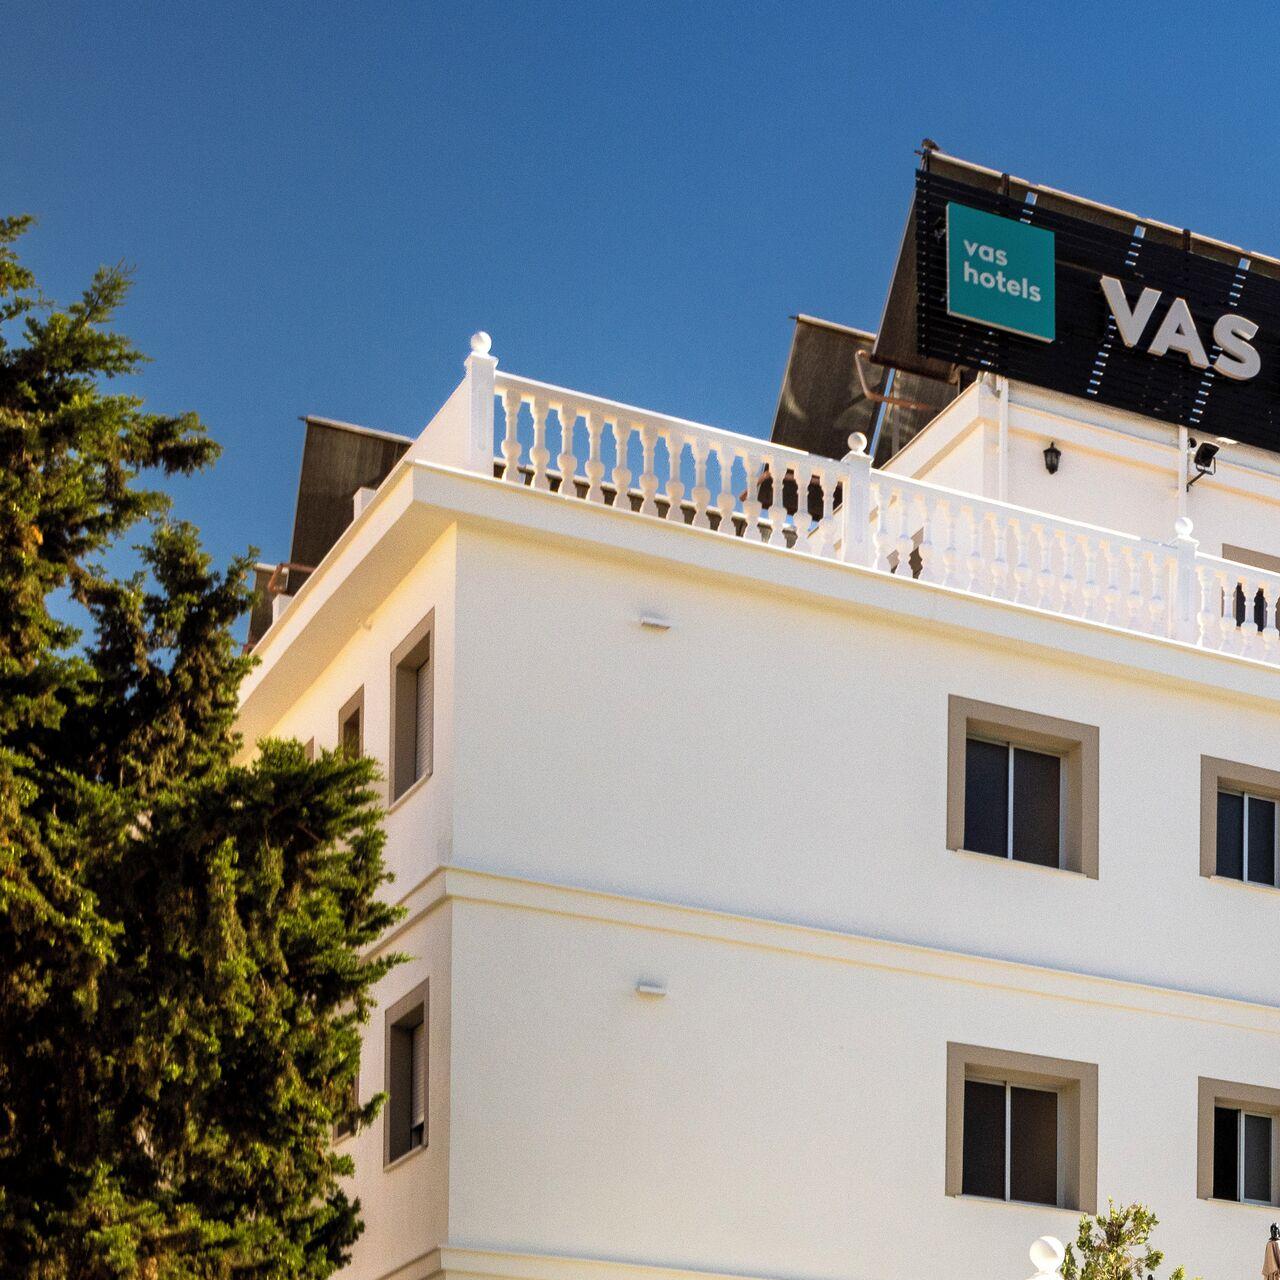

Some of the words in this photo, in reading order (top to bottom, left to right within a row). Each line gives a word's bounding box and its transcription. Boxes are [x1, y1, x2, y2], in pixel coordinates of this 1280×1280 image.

[963, 239, 1008, 266] vas
[963, 261, 1041, 302] hotels
[1100, 275, 1261, 381] VAS
